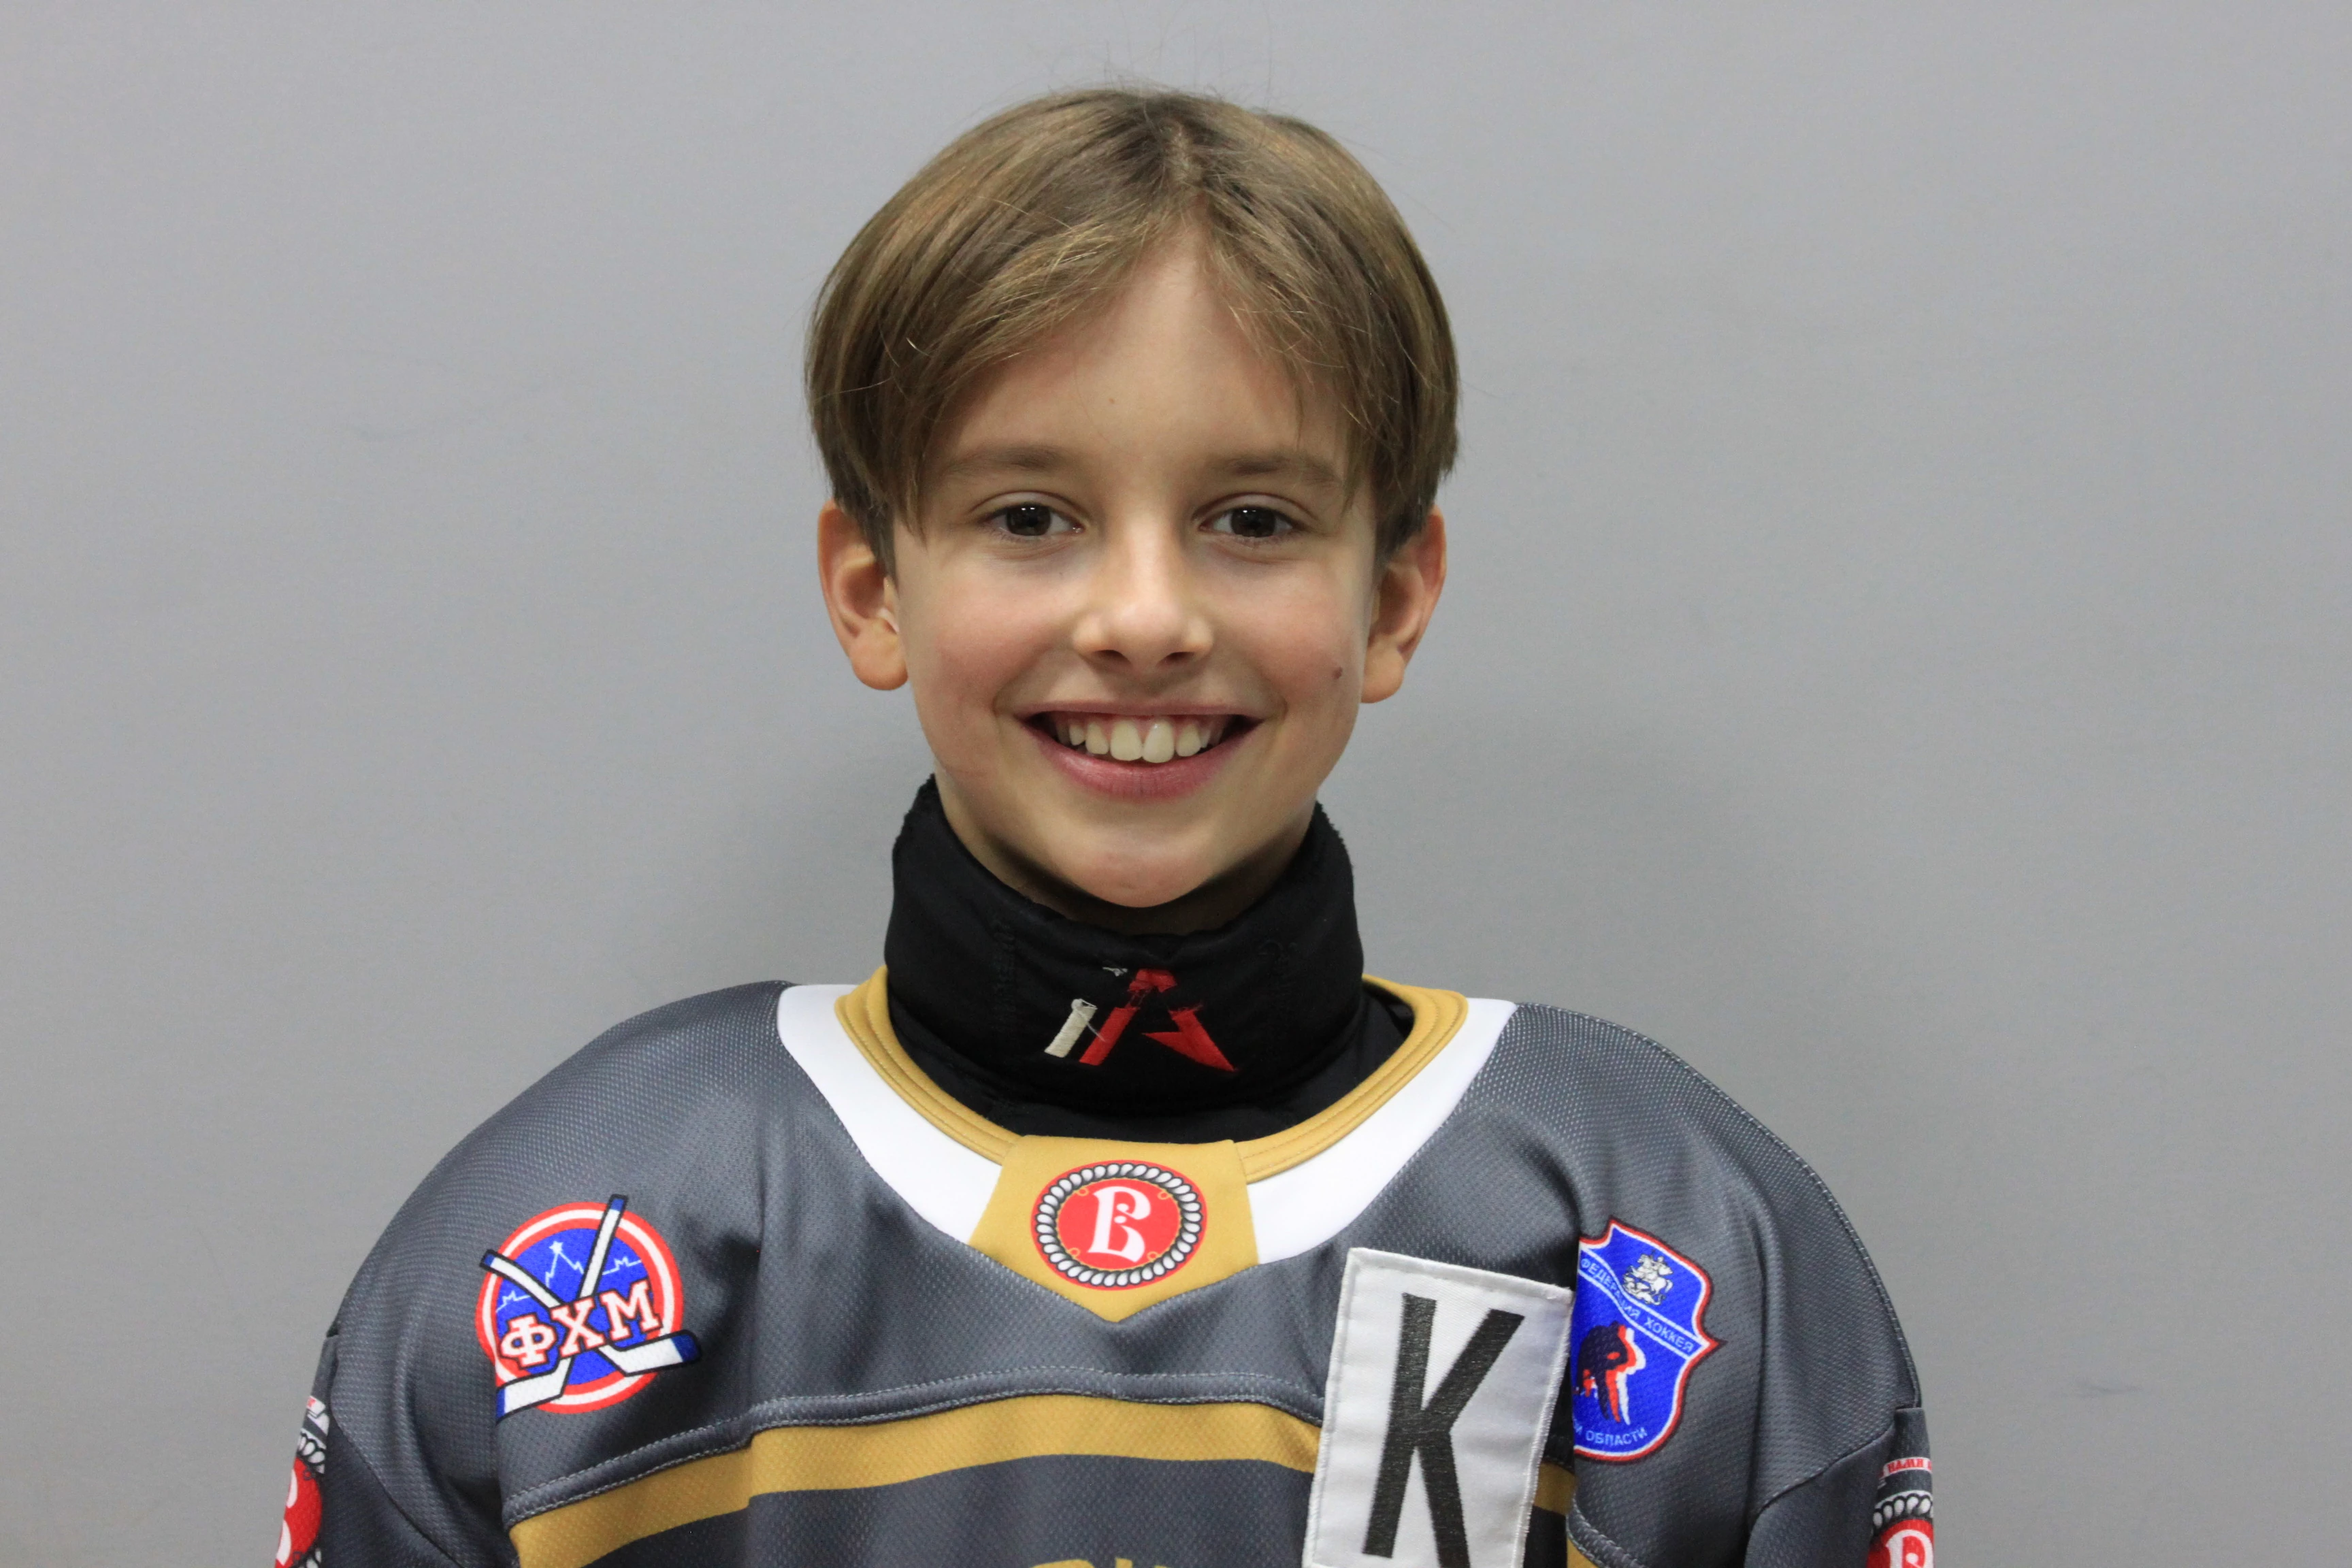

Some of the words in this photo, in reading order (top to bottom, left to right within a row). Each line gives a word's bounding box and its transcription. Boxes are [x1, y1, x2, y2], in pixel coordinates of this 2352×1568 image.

[499, 1277, 662, 1368] ФХМ
[1644, 1317, 1694, 1353] ХОККЕЯ
[1362, 1292, 1525, 1568] К
[1585, 1426, 1648, 1446] ОБЛАСТИ
